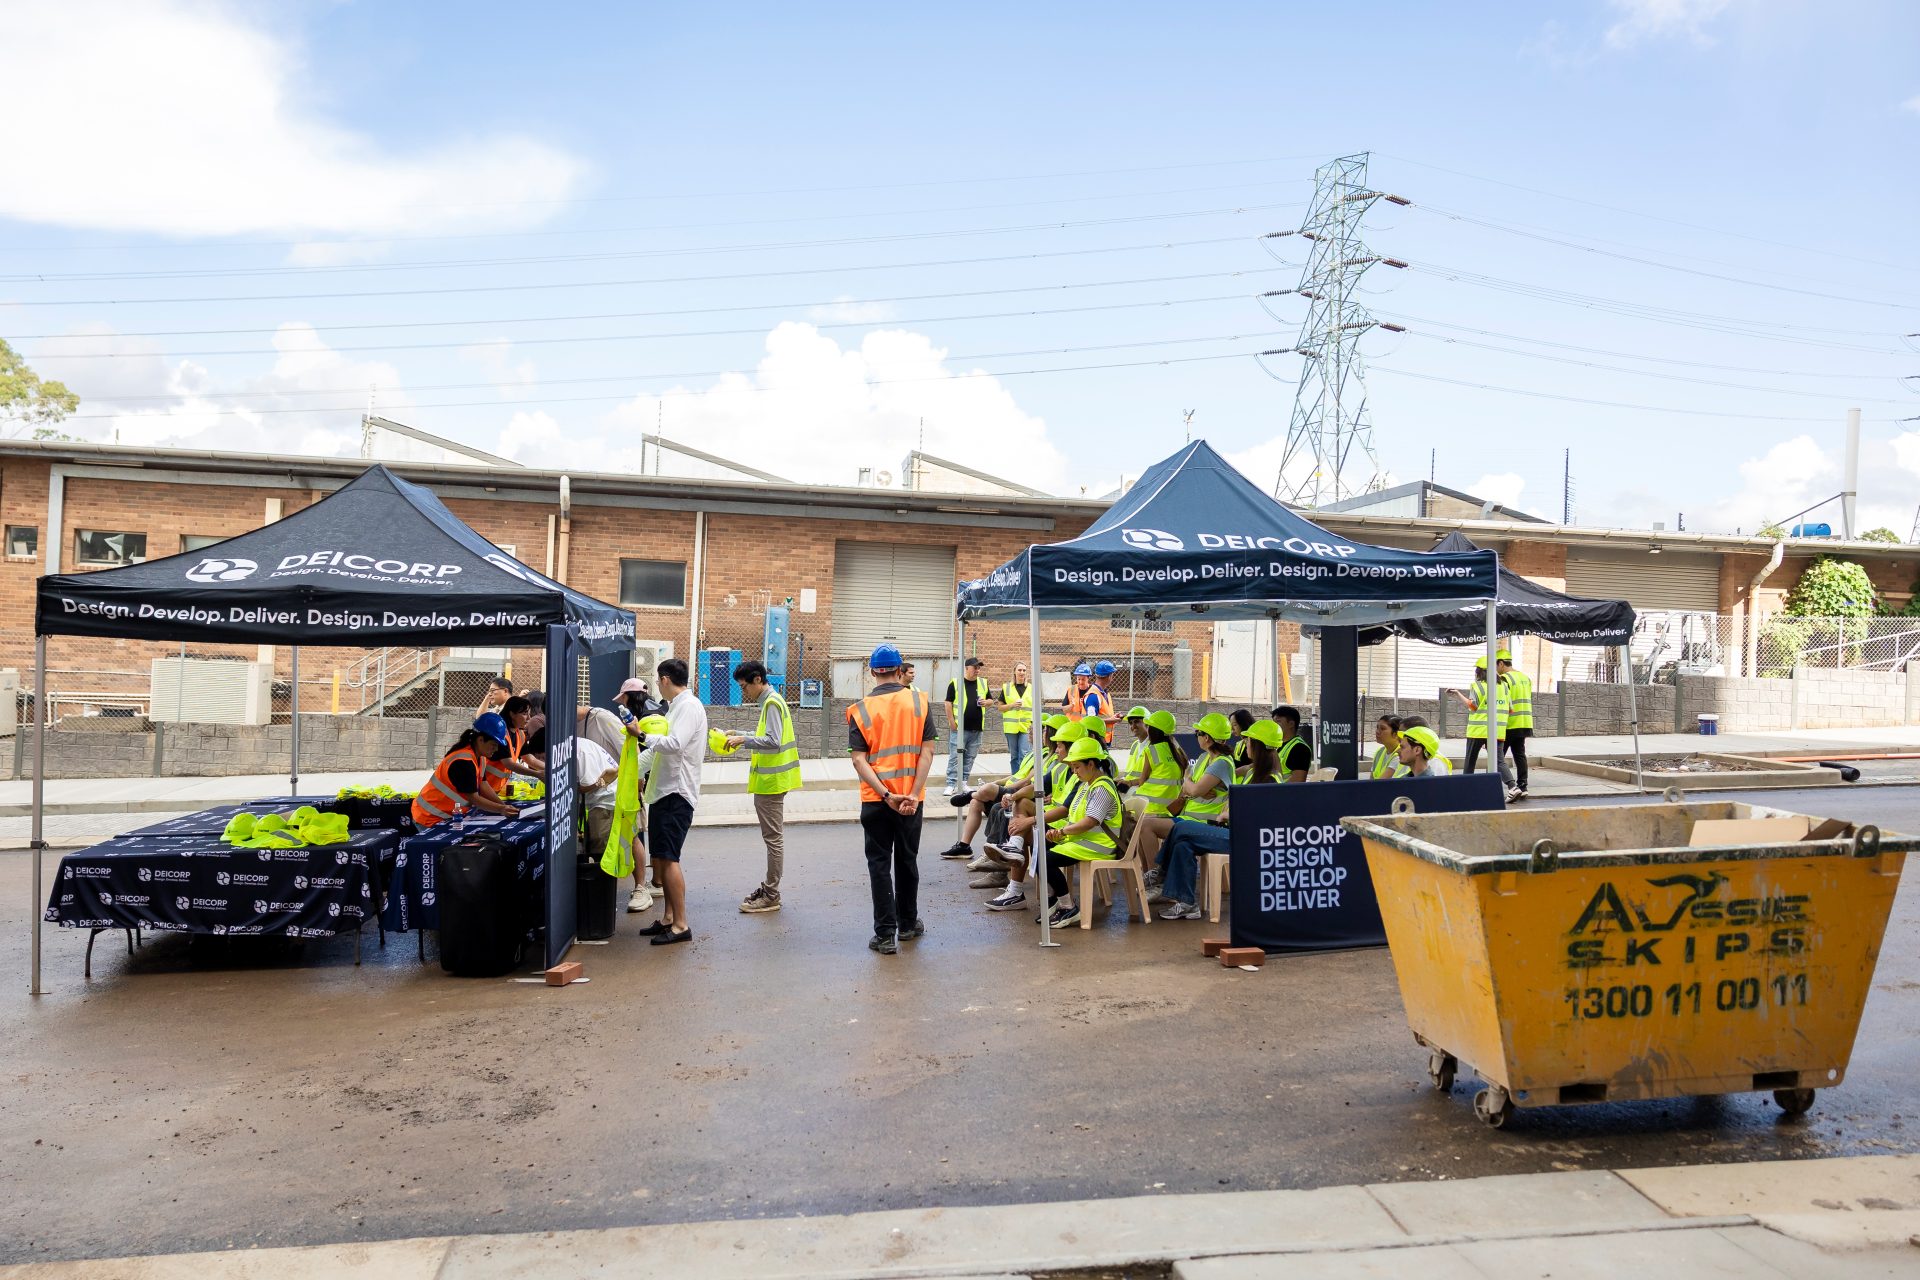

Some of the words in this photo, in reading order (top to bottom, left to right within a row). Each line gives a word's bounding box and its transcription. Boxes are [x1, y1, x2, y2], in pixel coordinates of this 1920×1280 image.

[1198, 533, 1357, 557] DEICORP
[276, 550, 462, 578] DEICORP
[269, 567, 325, 578] Design.
[327, 568, 394, 582] Develop.
[398, 576, 454, 586] Deliver.
[1055, 567, 1118, 586] Design.
[1122, 562, 1198, 583] Develop.
[1202, 562, 1264, 580] Deliver.
[1269, 562, 1332, 581] Design.
[1336, 563, 1411, 581] Develop.
[1413, 564, 1475, 578] Deliver.
[61, 598, 134, 620] Design.
[138, 604, 225, 625] Develop.
[229, 607, 301, 624] Deliver.
[307, 609, 379, 629] Design.
[382, 612, 465, 630] Develop.
[469, 611, 540, 627] Deliver.
[1451, 634, 1487, 644] Develop
[1554, 630, 1591, 640] Develop.
[1593, 627, 1627, 638] Deliver.
[1331, 723, 1351, 736] DEICORP
[1259, 824, 1348, 848] DEICORP
[274, 850, 310, 858] DEICORP
[1260, 846, 1333, 869] DESIGN
[76, 867, 112, 875] DEICORP
[154, 870, 191, 878] DEICORP
[233, 874, 269, 882] DEICORP
[1260, 867, 1347, 890] DEVELOP
[311, 877, 345, 885] DEICORP
[115, 894, 150, 903] DEICORP
[193, 898, 228, 906] DEICORP
[270, 902, 304, 910] DEICORP
[1260, 888, 1341, 912] DELIVER
[400, 895, 408, 930] DEICORP
[302, 927, 336, 937] DEICORP
[1567, 928, 1807, 969] SKIPS
[1565, 983, 1653, 1020] 1300
[1666, 980, 1702, 1016] 11
[1716, 977, 1759, 1012] 00
[1773, 973, 1808, 1007] 11
